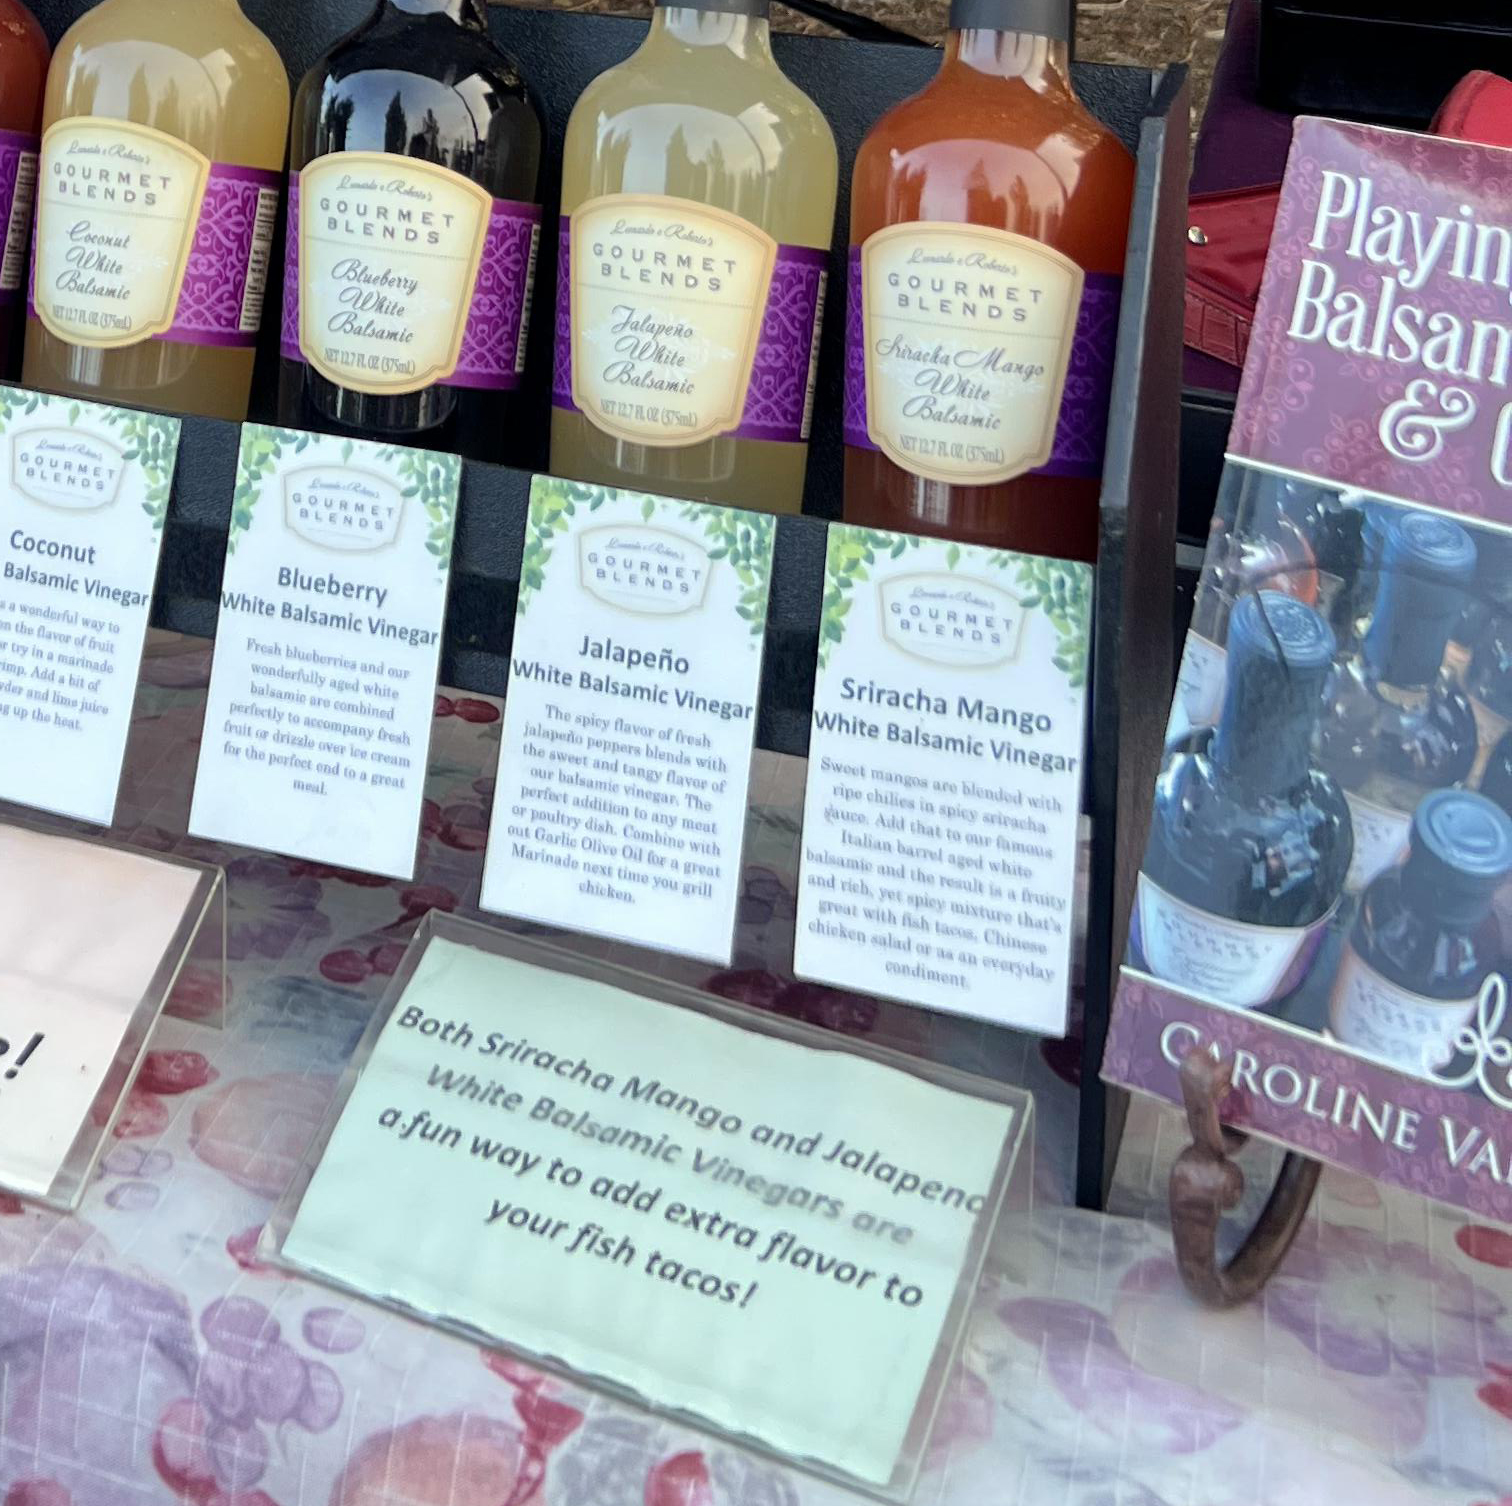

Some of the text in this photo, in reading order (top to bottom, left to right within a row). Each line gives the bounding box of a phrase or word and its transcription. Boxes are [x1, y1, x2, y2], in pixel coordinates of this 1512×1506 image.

[1308, 170, 1512, 290] Playin
[331, 259, 419, 294] Blueberry
[592, 242, 736, 274] GOURMET
[600, 262, 721, 292] BLENDS
[338, 289, 406, 319] White
[887, 271, 1042, 304] GOURMET
[897, 293, 1027, 322] BLENDS
[327, 312, 414, 345] Balsamic
[615, 334, 686, 368] White
[952, 347, 1045, 382] Mango
[603, 362, 695, 396] Balsamic
[914, 369, 991, 403] White
[902, 395, 1001, 430] Balsamic
[1379, 378, 1477, 462] &
[9, 529, 96, 565] Coconut
[3, 561, 79, 592] Balsamic
[84, 577, 149, 607] Vinegar
[277, 566, 387, 608] Blueberry
[221, 589, 438, 646] White Balsamic Vinegar
[578, 635, 689, 674] Jalapeño
[512, 657, 753, 721] White Balsamic Vinegar
[840, 677, 1051, 735] Sriracha Mango
[544, 703, 711, 750] The spicy flavor of fresh
[814, 709, 1077, 773] White Balsamic Vinegar
[396, 1004, 474, 1049] Both
[477, 1031, 614, 1092] Sriracha
[619, 1075, 742, 1134] Mango
[750, 1124, 823, 1157] and
[1160, 1021, 1512, 1186] CROLINE VA
[426, 1063, 913, 1244] White Balsamic Vinegars are
[377, 1107, 923, 1307] a fun way to add extra flavor to
[483, 1198, 758, 1308] your fish tacos!
